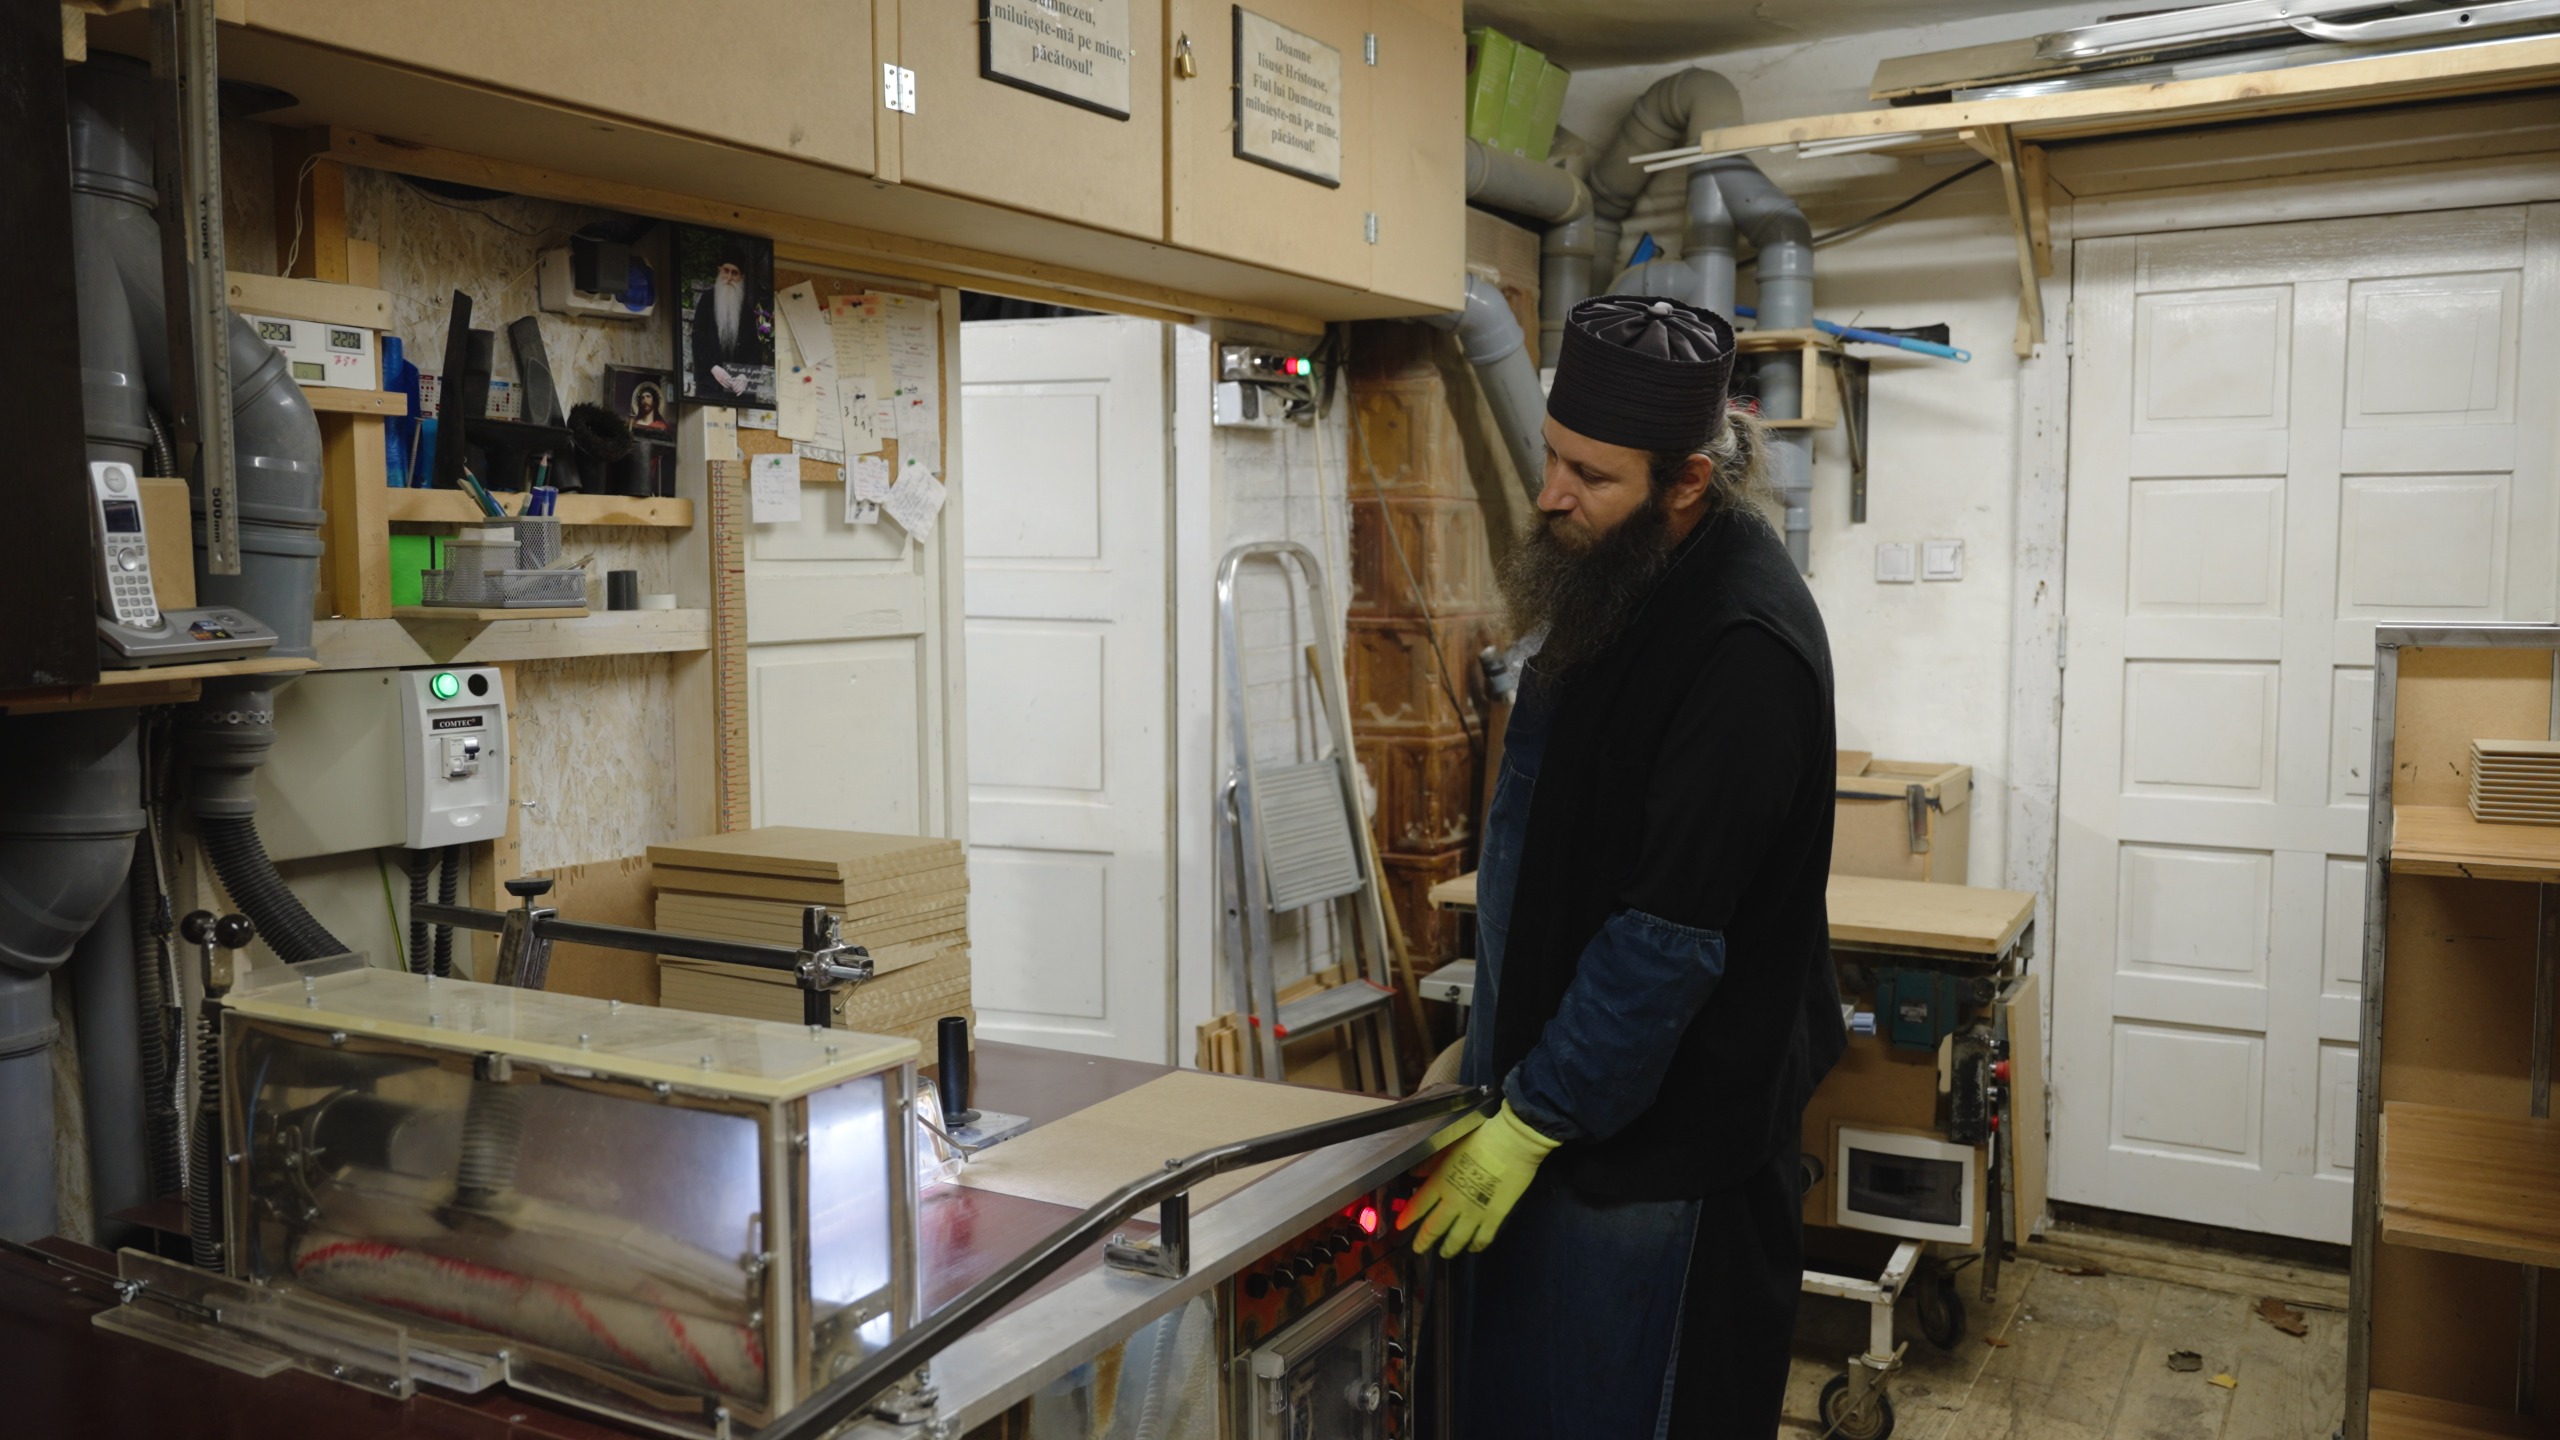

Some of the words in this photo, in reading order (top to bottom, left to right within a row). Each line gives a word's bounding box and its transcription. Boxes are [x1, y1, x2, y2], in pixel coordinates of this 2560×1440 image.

[1028, 0, 1096, 28] umnezeu,
[1032, 44, 1093, 77] păcătosul!
[1078, 33, 1092, 51] pe
[1095, 40, 1126, 65] mine,
[1276, 36, 1311, 64] Doamne
[1258, 52, 1283, 75] Iisuse
[1286, 63, 1328, 94] Hristoase,
[1253, 73, 1272, 94] Fiul
[1274, 85, 1286, 98] lui
[1288, 87, 1335, 118] Dumnezeu,
[1271, 128, 1316, 153] păcătosul!
[1304, 117, 1315, 132] pe
[1316, 121, 1339, 142] mine,
[201, 214, 209, 260] TOPEX
[212, 487, 222, 543] 500mm
[439, 719, 472, 728] COMTEC
